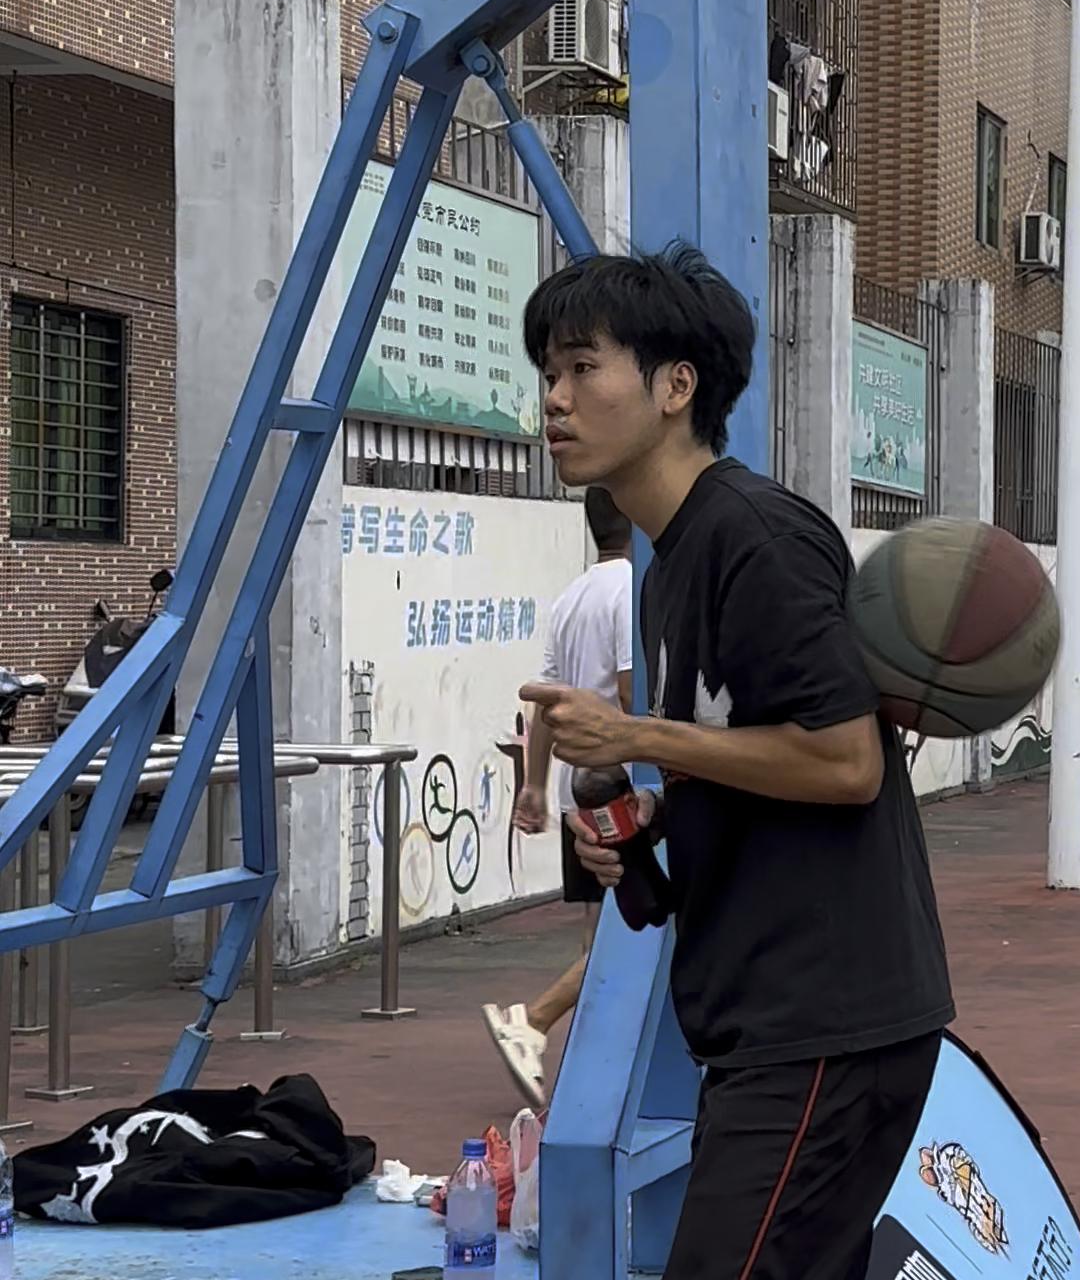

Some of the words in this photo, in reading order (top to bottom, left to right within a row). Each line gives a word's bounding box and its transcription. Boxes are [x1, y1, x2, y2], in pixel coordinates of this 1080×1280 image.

[407, 597, 536, 647] 弘扬运动精神
